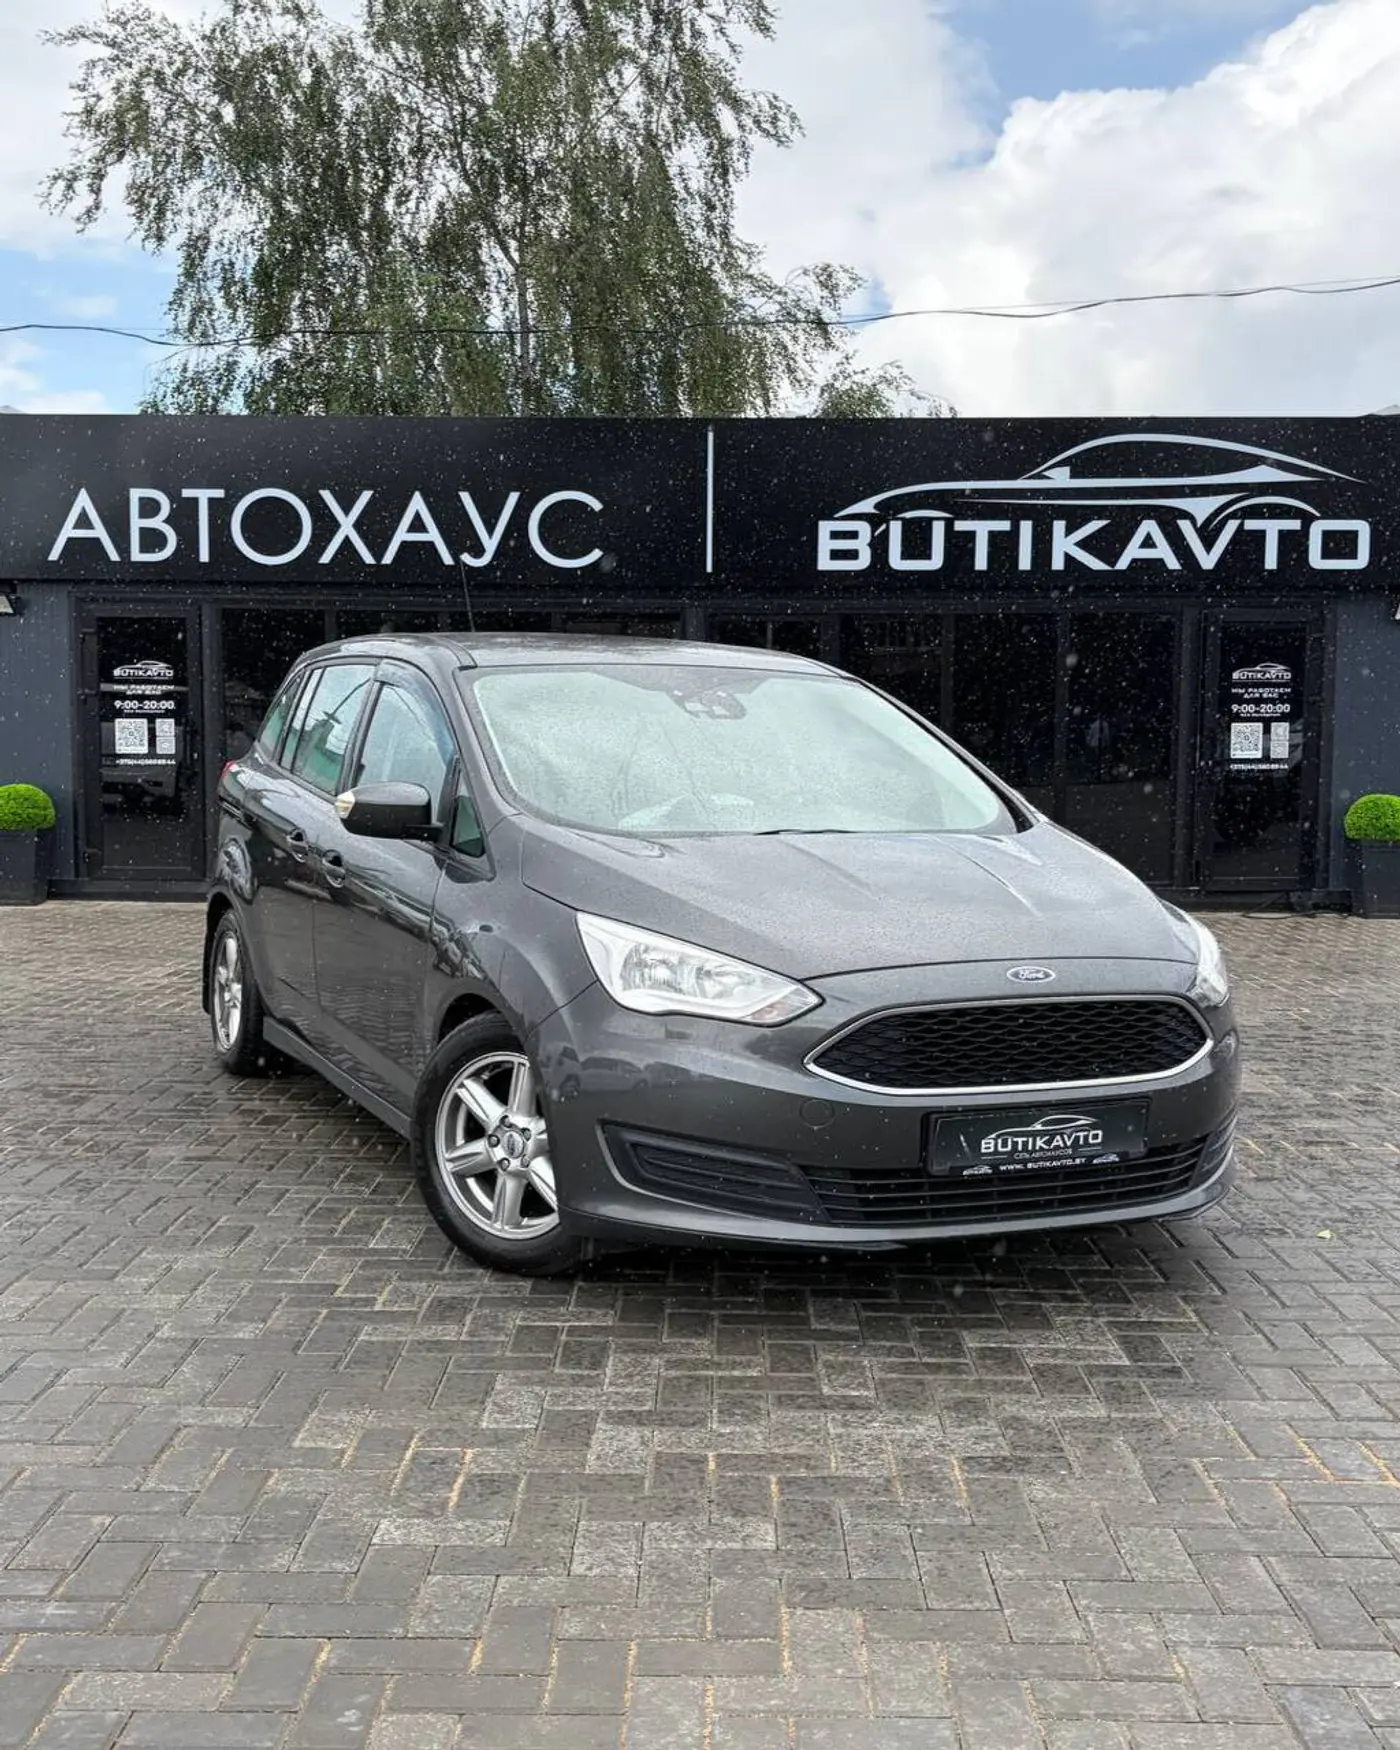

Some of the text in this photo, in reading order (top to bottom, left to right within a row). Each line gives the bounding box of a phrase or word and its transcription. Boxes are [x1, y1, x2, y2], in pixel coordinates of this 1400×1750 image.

[48, 487, 605, 568] АВТОХАУС
[817, 518, 1371, 572] BUTIKAVTO
[113, 669, 174, 677] BUTIKAVTO
[1231, 671, 1292, 680] BUTIKAVTO
[113, 700, 175, 710] 9:00-20:00
[1231, 703, 1291, 713] 9:00-20:00
[981, 1130, 1103, 1153] BUTIKAVTO
